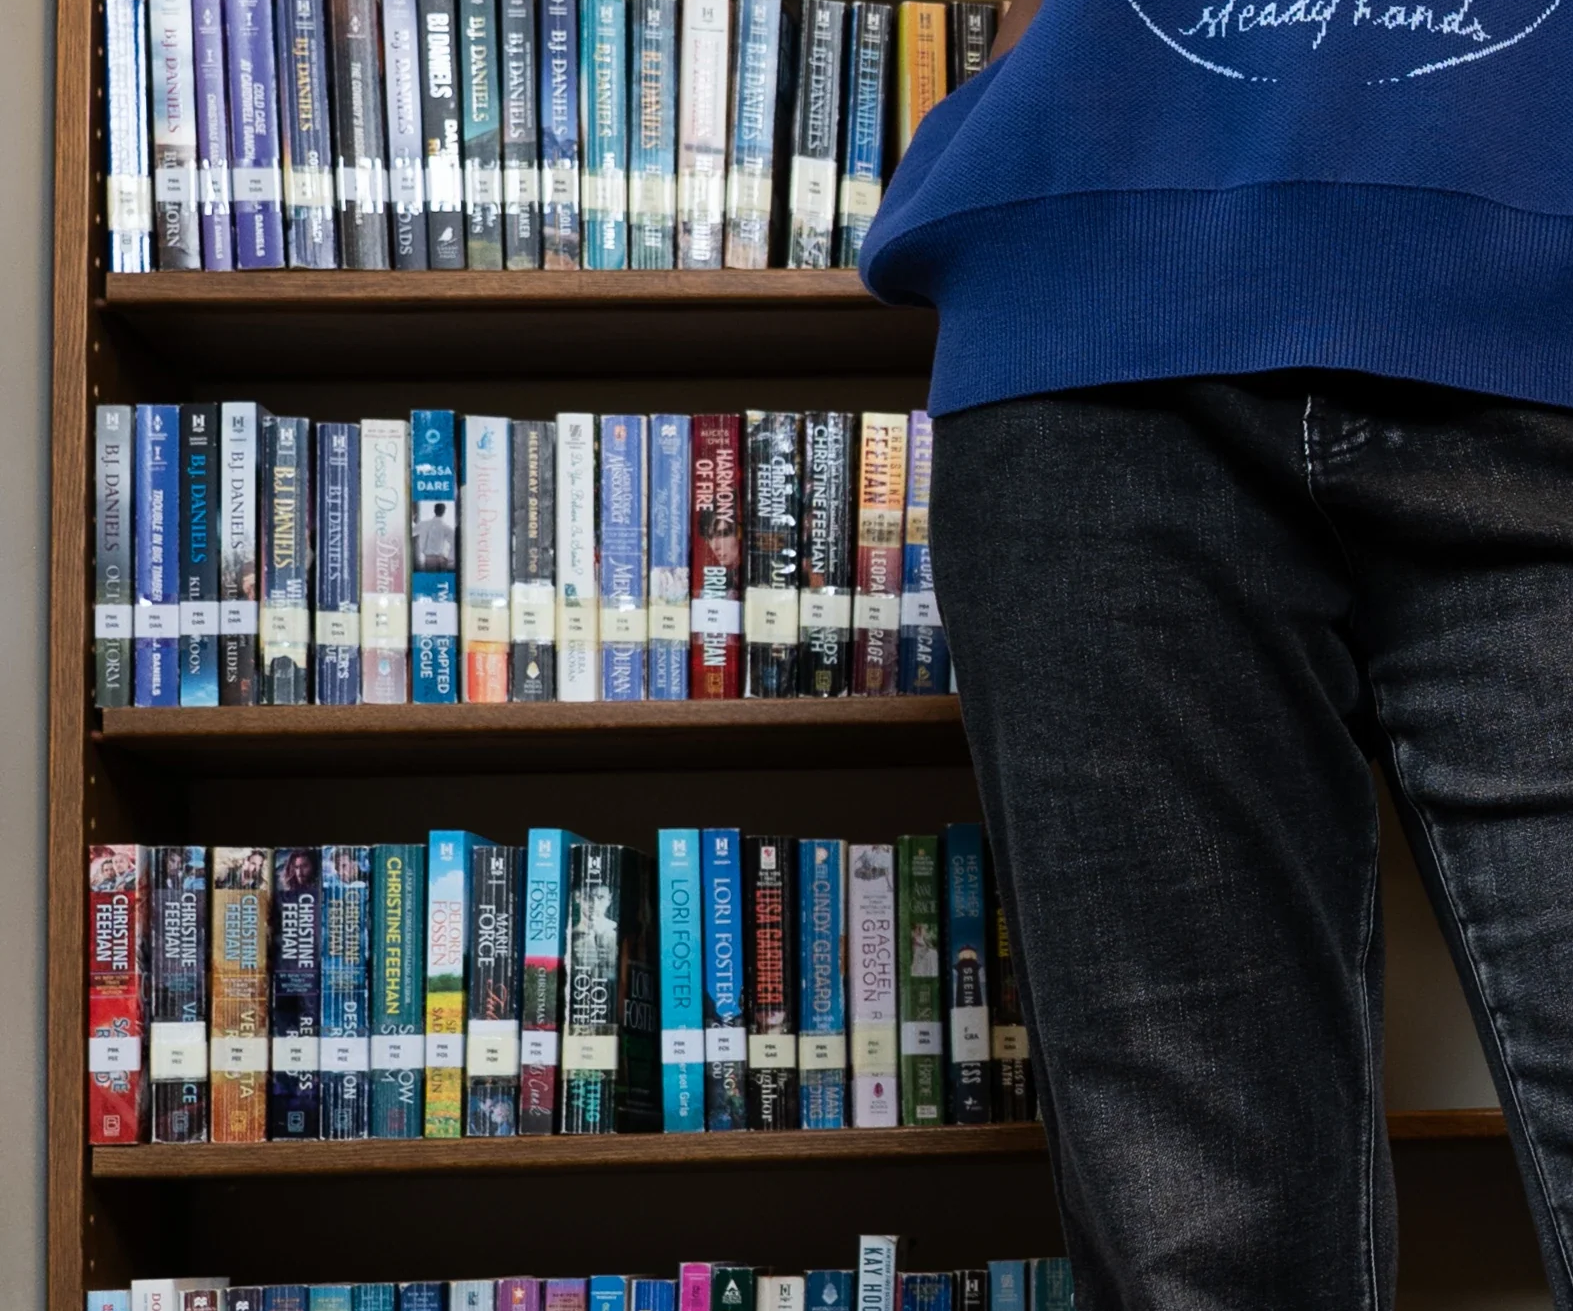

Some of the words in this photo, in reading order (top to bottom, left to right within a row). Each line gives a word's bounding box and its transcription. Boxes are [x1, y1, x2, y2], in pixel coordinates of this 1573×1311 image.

[165, 57, 181, 133] DANIELS
[471, 45, 490, 121] DANIELS
[186, 453, 205, 478] B.J.
[374, 442, 400, 489] Tessa
[696, 459, 713, 478] OF
[716, 448, 734, 523] HARMONY
[190, 483, 208, 563] DANIELS
[375, 489, 398, 536] Dare
[696, 482, 714, 512] FIRE
[529, 879, 544, 941] FOSSEN
[544, 880, 559, 940] DELORES
[671, 878, 691, 924] LORI
[756, 888, 782, 922] LISA
[812, 879, 831, 934] CINDY
[953, 855, 965, 918] GRAHAM
[967, 854, 980, 918] HEATHER
[96, 903, 112, 961] FEEHAN
[112, 894, 128, 970] CHRISTINE
[282, 902, 298, 959] FEEHAN
[298, 893, 315, 969] CHRISTINE
[477, 904, 495, 968] FORCE
[496, 913, 508, 958] MARIE
[862, 918, 877, 1002] GIBSON
[877, 918, 891, 1002] RACHEL
[671, 930, 692, 1009] FOSTER
[757, 928, 784, 1003] GARDNER
[813, 940, 832, 1013] GERARD
[862, 1247, 885, 1275] KAY
